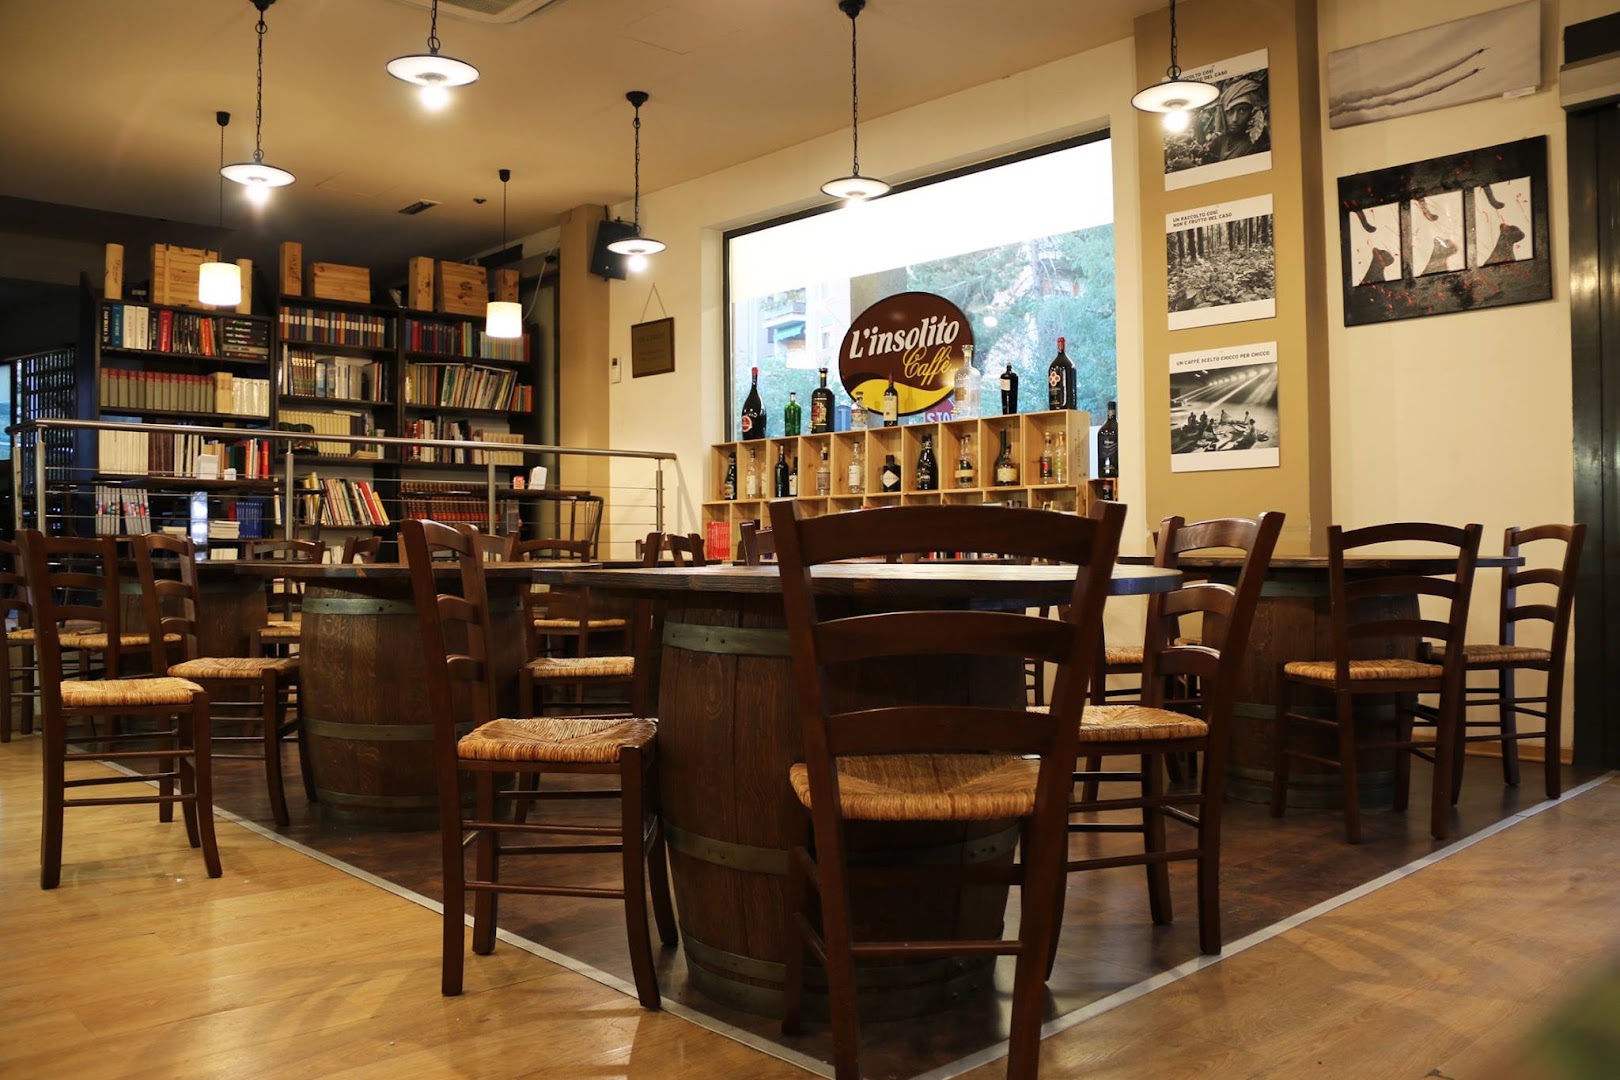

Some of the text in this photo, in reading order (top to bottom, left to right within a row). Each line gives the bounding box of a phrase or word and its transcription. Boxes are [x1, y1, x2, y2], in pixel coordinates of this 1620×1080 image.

[1181, 212, 1206, 221] RACCOLTO
[1188, 216, 1207, 225] FRUTTO
[849, 315, 960, 359] L'insolito
[926, 411, 953, 423] STO
